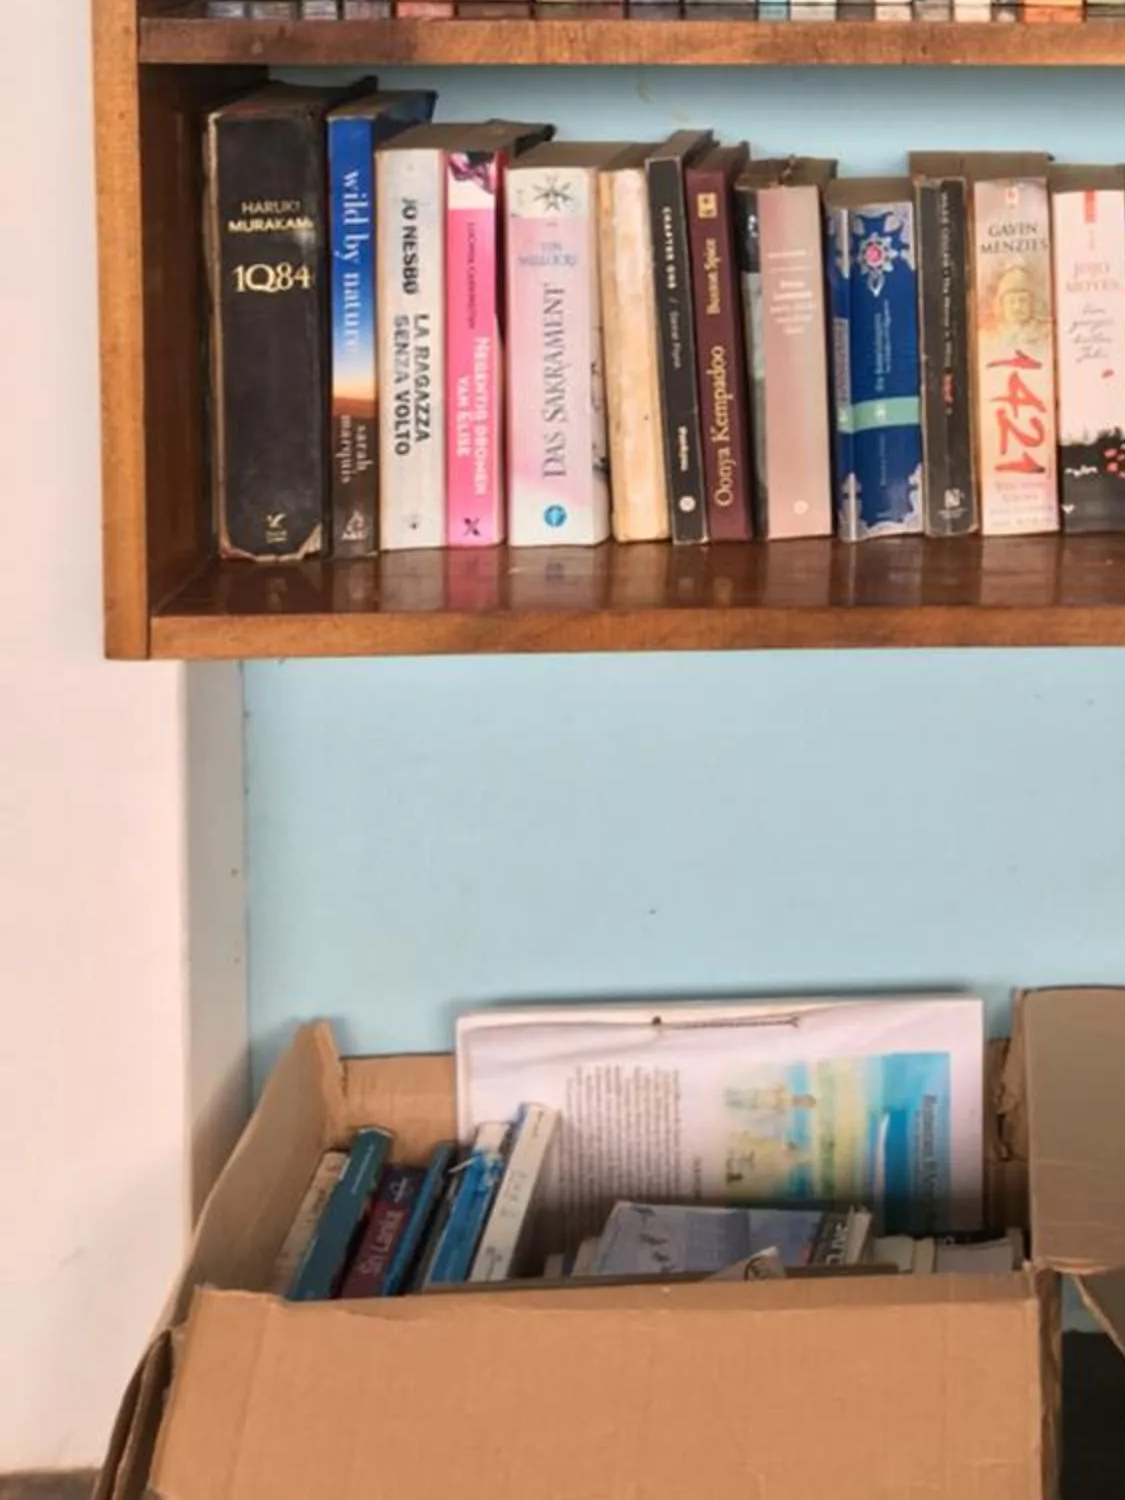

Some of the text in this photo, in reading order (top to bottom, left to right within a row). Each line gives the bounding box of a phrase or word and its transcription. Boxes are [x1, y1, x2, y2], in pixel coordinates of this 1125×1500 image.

[402, 198, 418, 220] JO
[988, 223, 1038, 237] GAVIN
[233, 261, 310, 292] 1Q84
[333, 170, 371, 348] wild by nature
[981, 238, 1049, 254] MENZIES
[394, 313, 411, 455] SENZA VOLTO
[414, 313, 431, 442] LA RAGAZZA
[540, 283, 570, 478] DAS SAKRAMENT
[706, 346, 733, 441] Kempadoo
[985, 350, 1047, 474] 1421
[336, 414, 356, 483] marquis
[356, 424, 372, 470] sarah
[714, 447, 736, 506] Oonya
